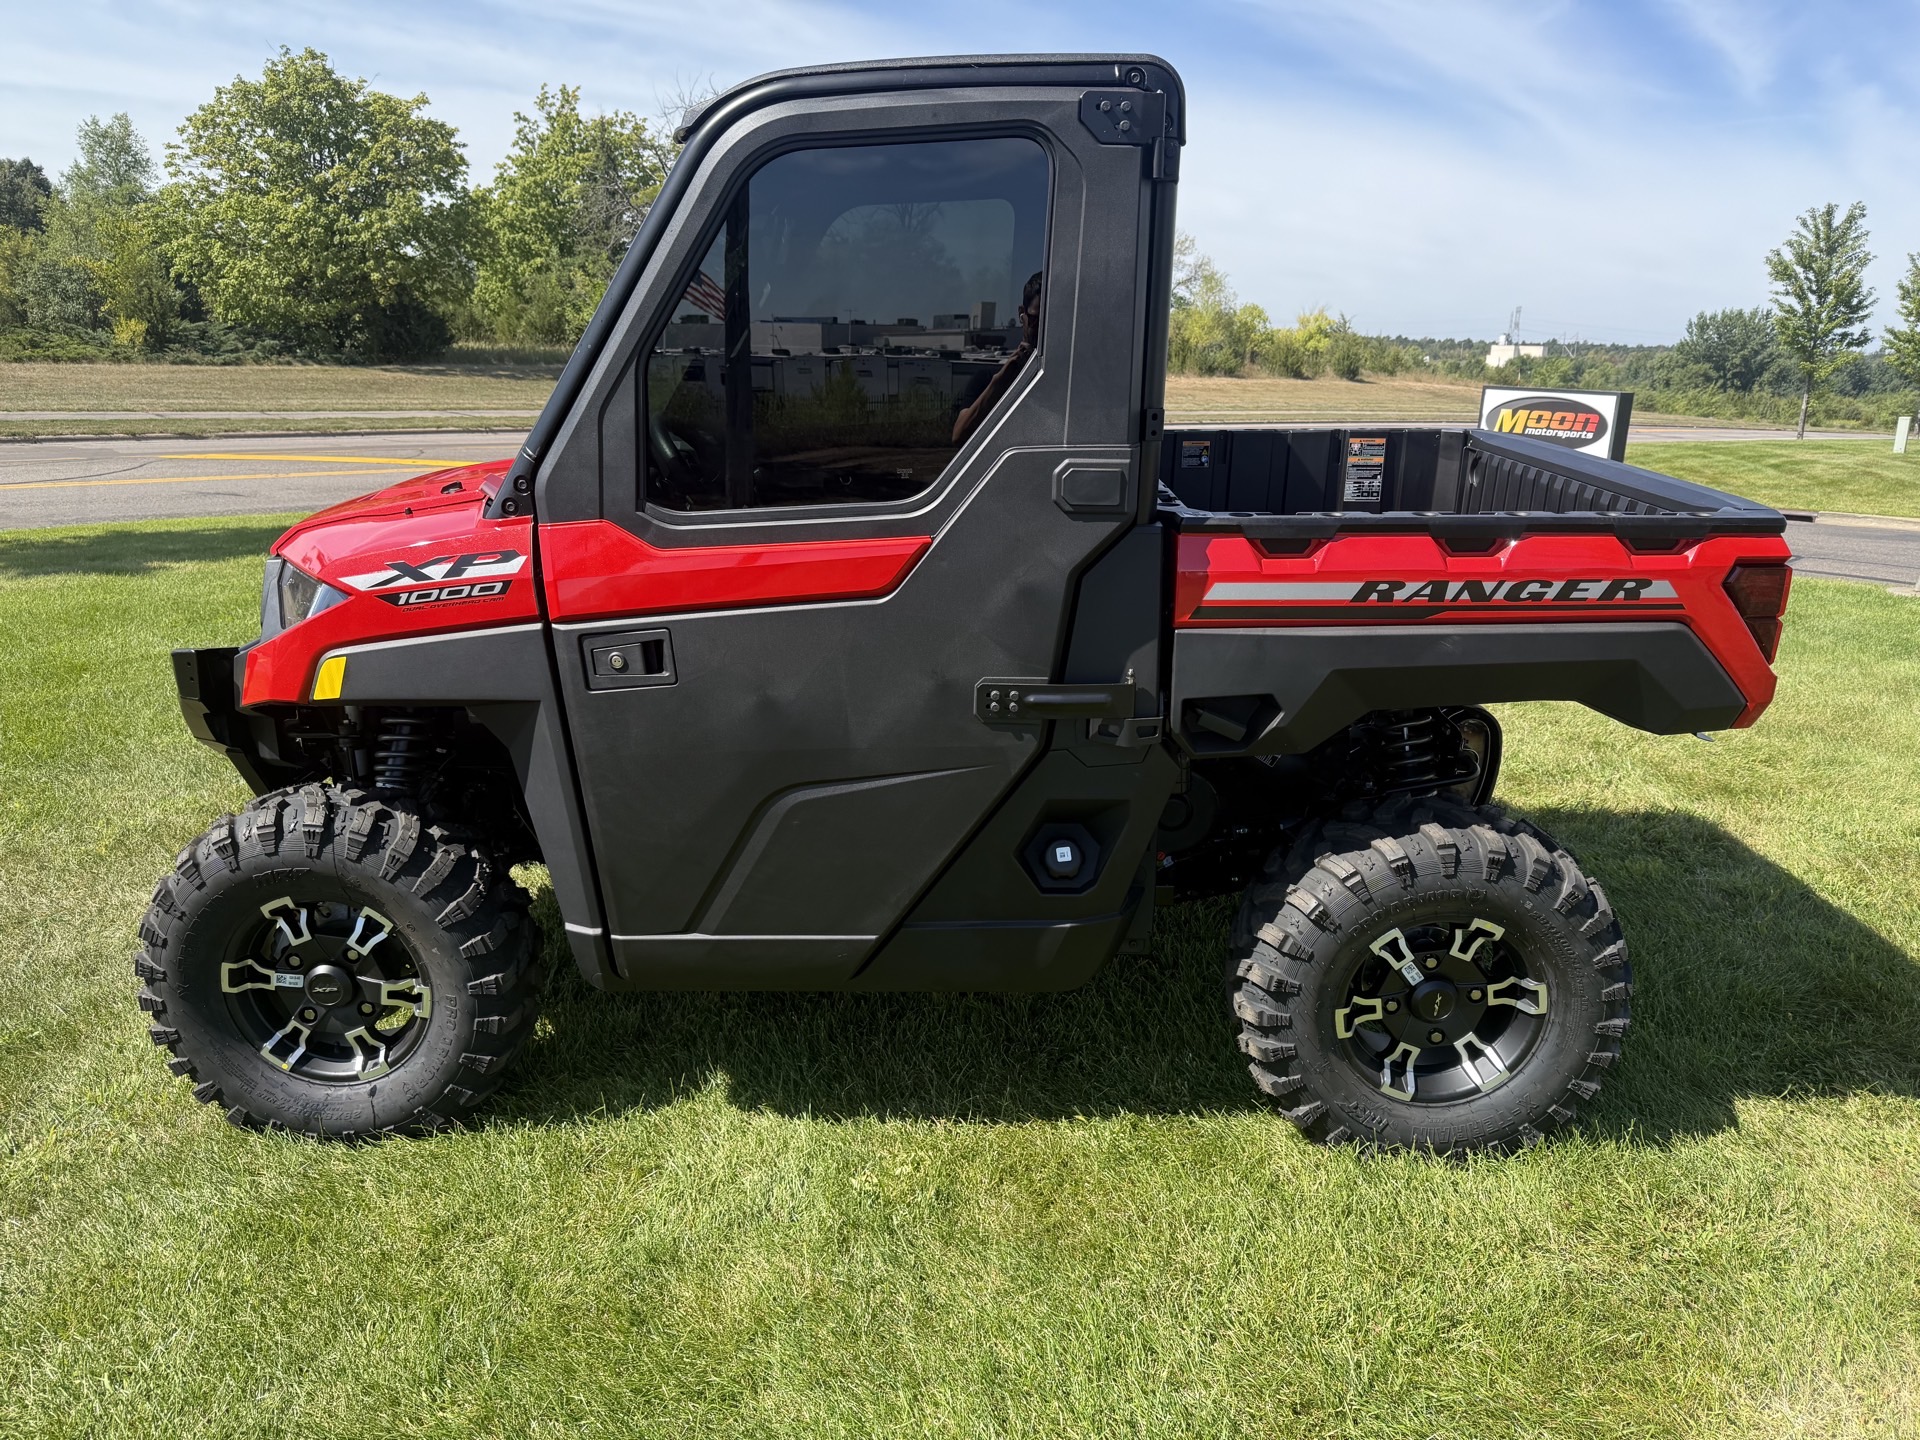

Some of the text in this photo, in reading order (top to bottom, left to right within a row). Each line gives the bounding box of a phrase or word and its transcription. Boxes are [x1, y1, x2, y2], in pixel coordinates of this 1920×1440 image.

[1525, 427, 1594, 439] motorsports
[366, 549, 522, 589] XP
[398, 582, 503, 605] 1000
[1350, 578, 1653, 603] RANGER
[402, 605, 428, 613] DUAL
[429, 599, 481, 610] OVERHEAD
